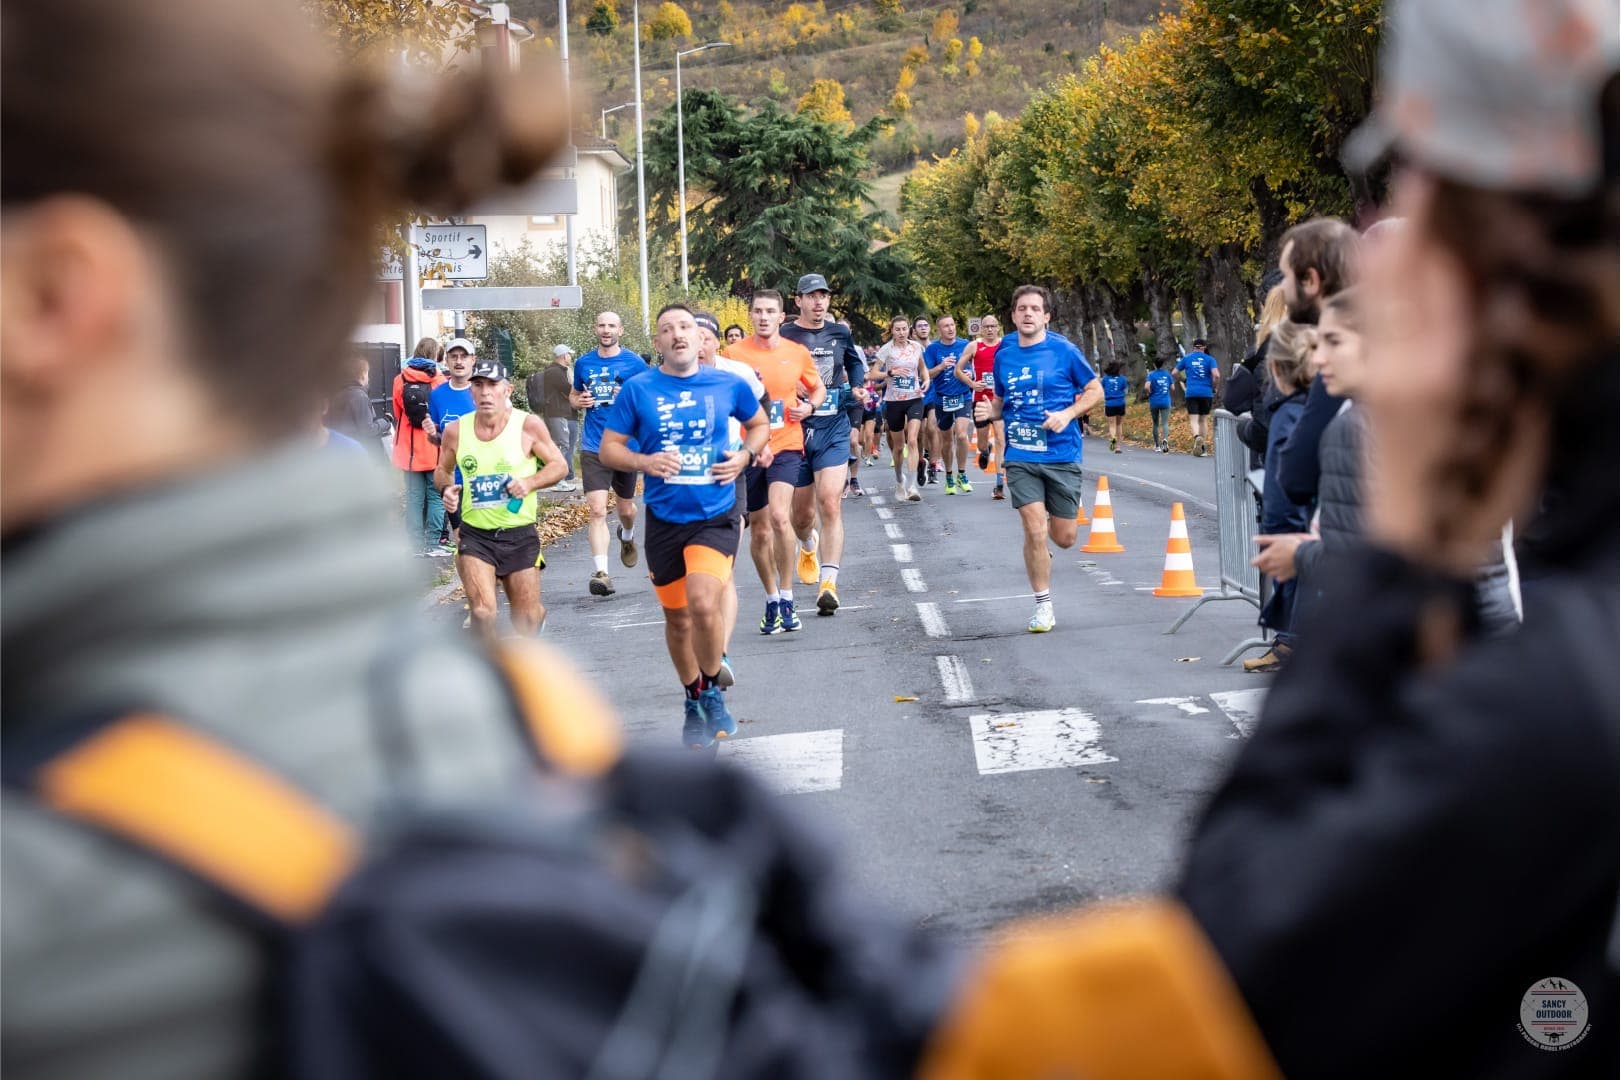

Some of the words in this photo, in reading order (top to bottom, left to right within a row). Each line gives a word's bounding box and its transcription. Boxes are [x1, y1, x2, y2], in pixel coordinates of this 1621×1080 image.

[424, 231, 460, 245] Sportif
[594, 385, 613, 394] 1939
[1016, 427, 1038, 438] 1852
[476, 480, 500, 493] 1499
